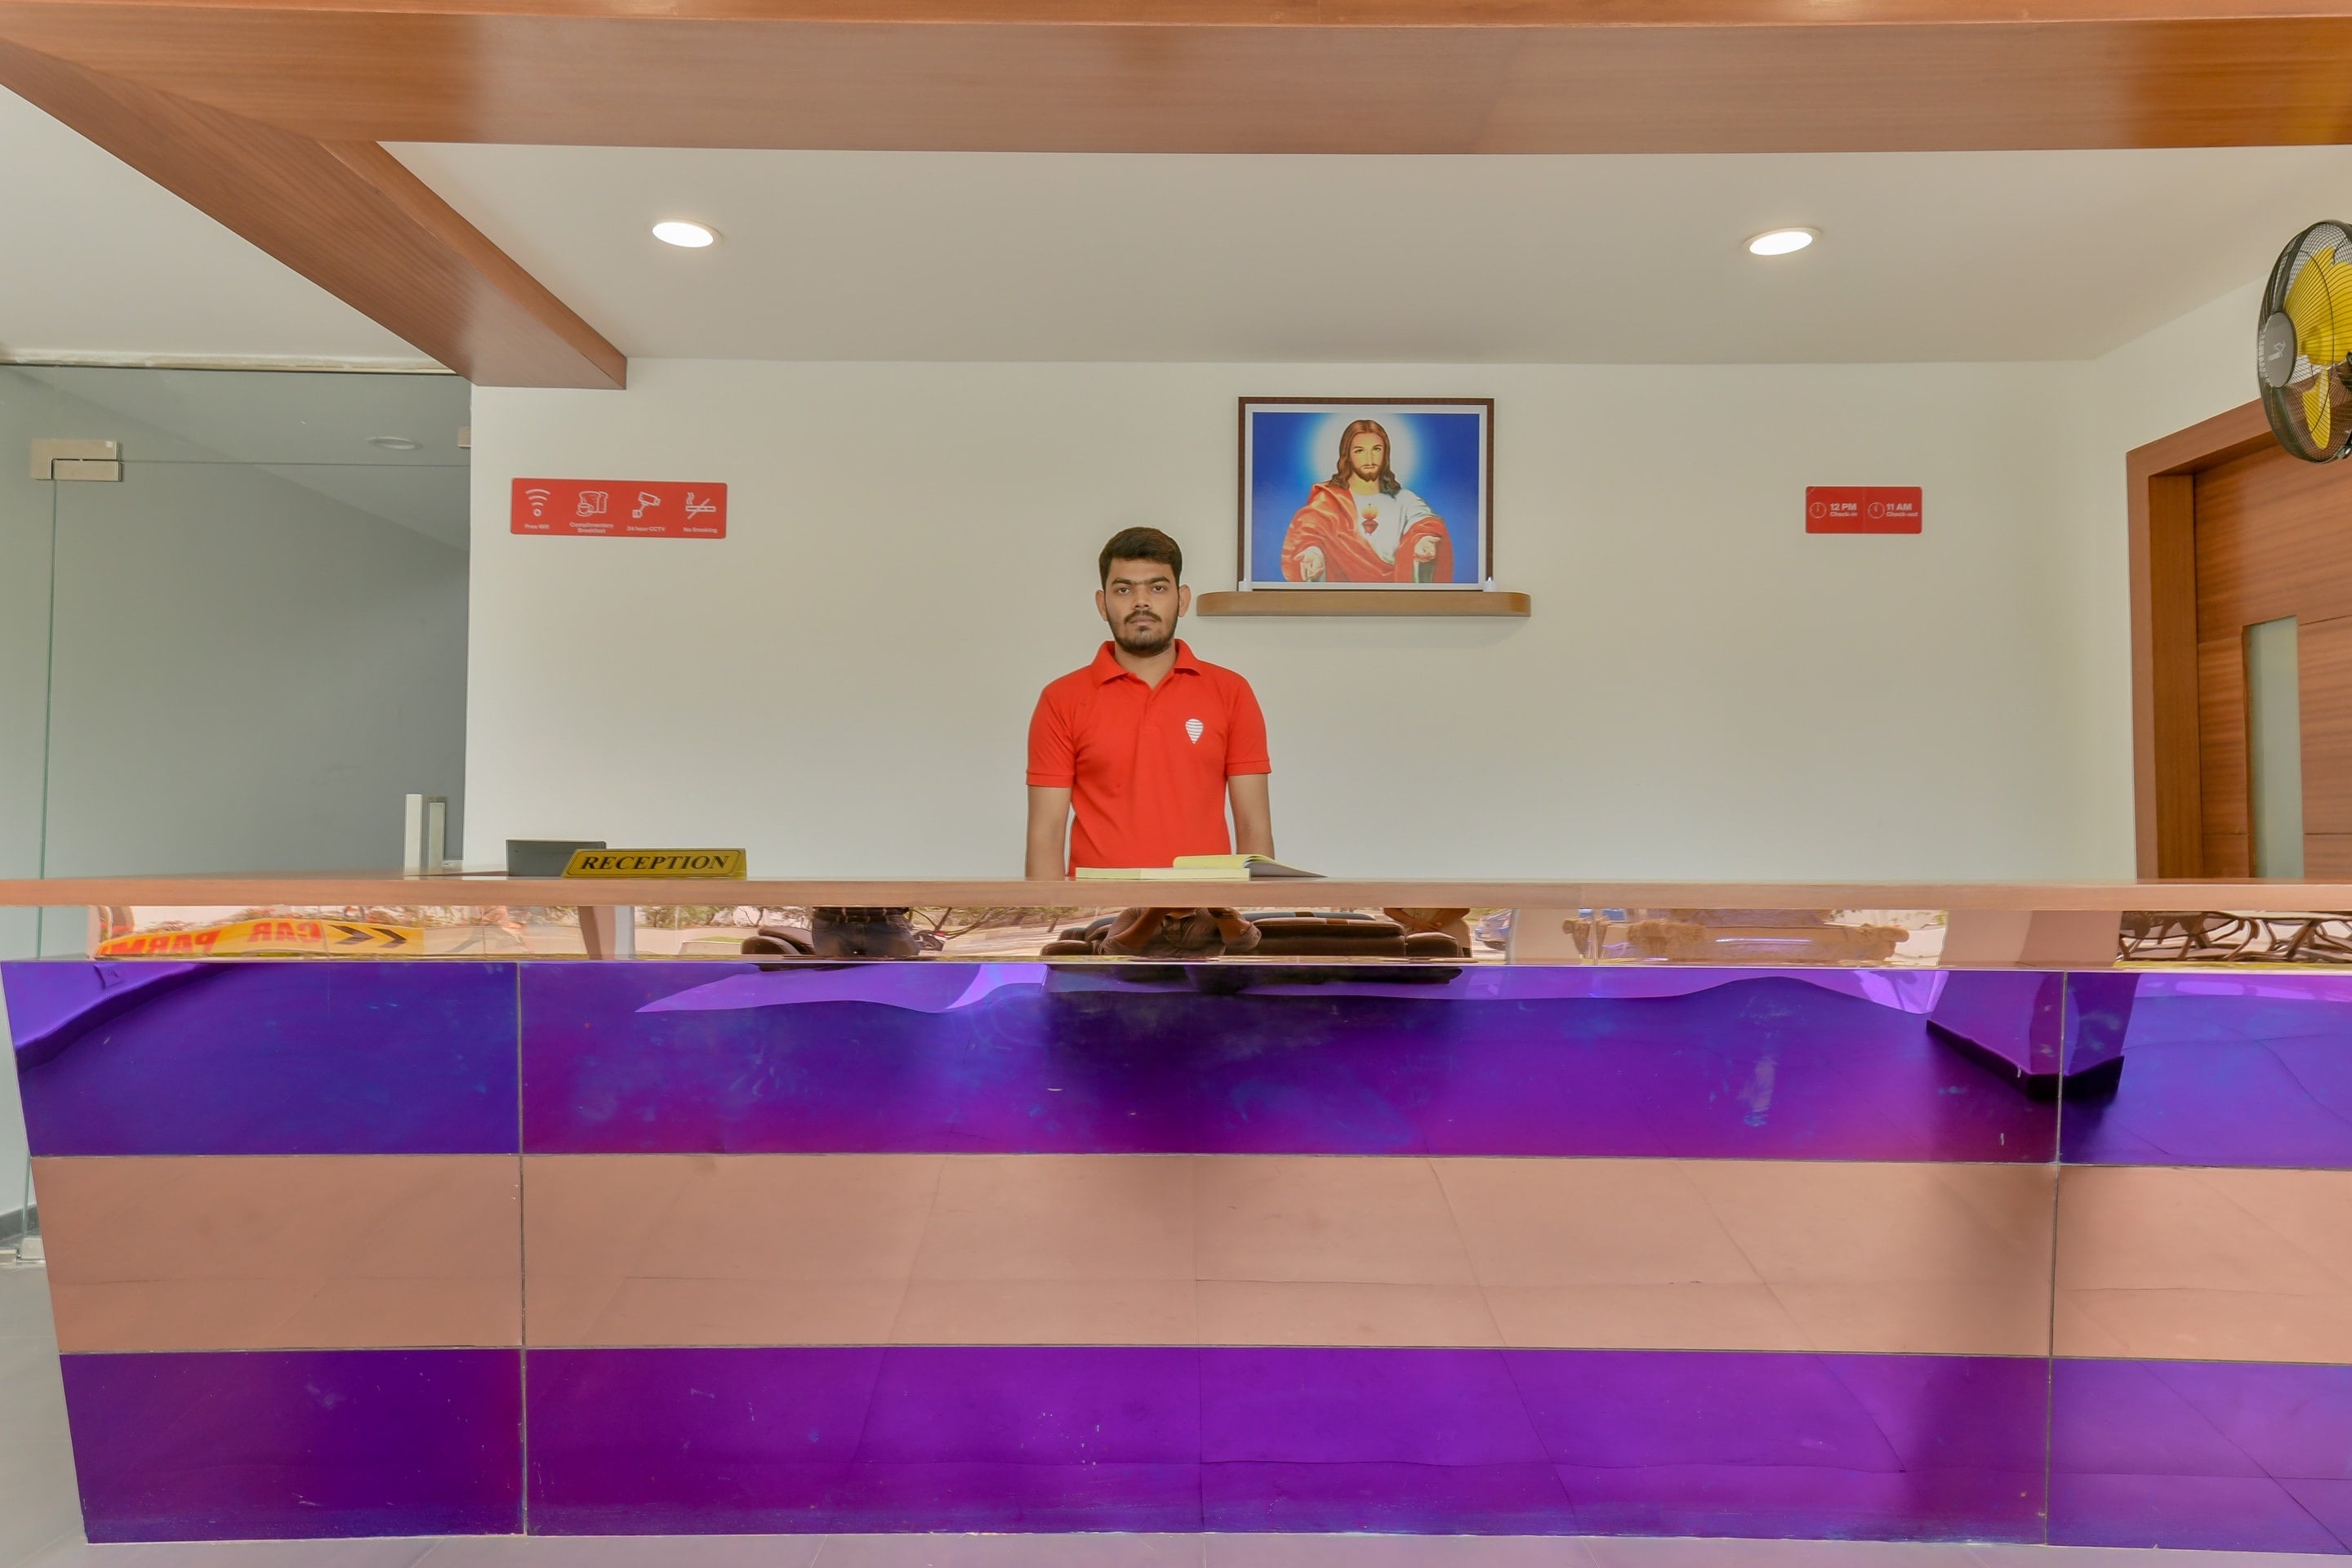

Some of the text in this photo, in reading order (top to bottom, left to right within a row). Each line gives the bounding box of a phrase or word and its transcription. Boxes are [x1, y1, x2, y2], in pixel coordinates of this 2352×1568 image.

[1829, 503, 1857, 511] 12 PM
[1886, 503, 1913, 511] 11 AM
[581, 855, 730, 871] RECEPTION
